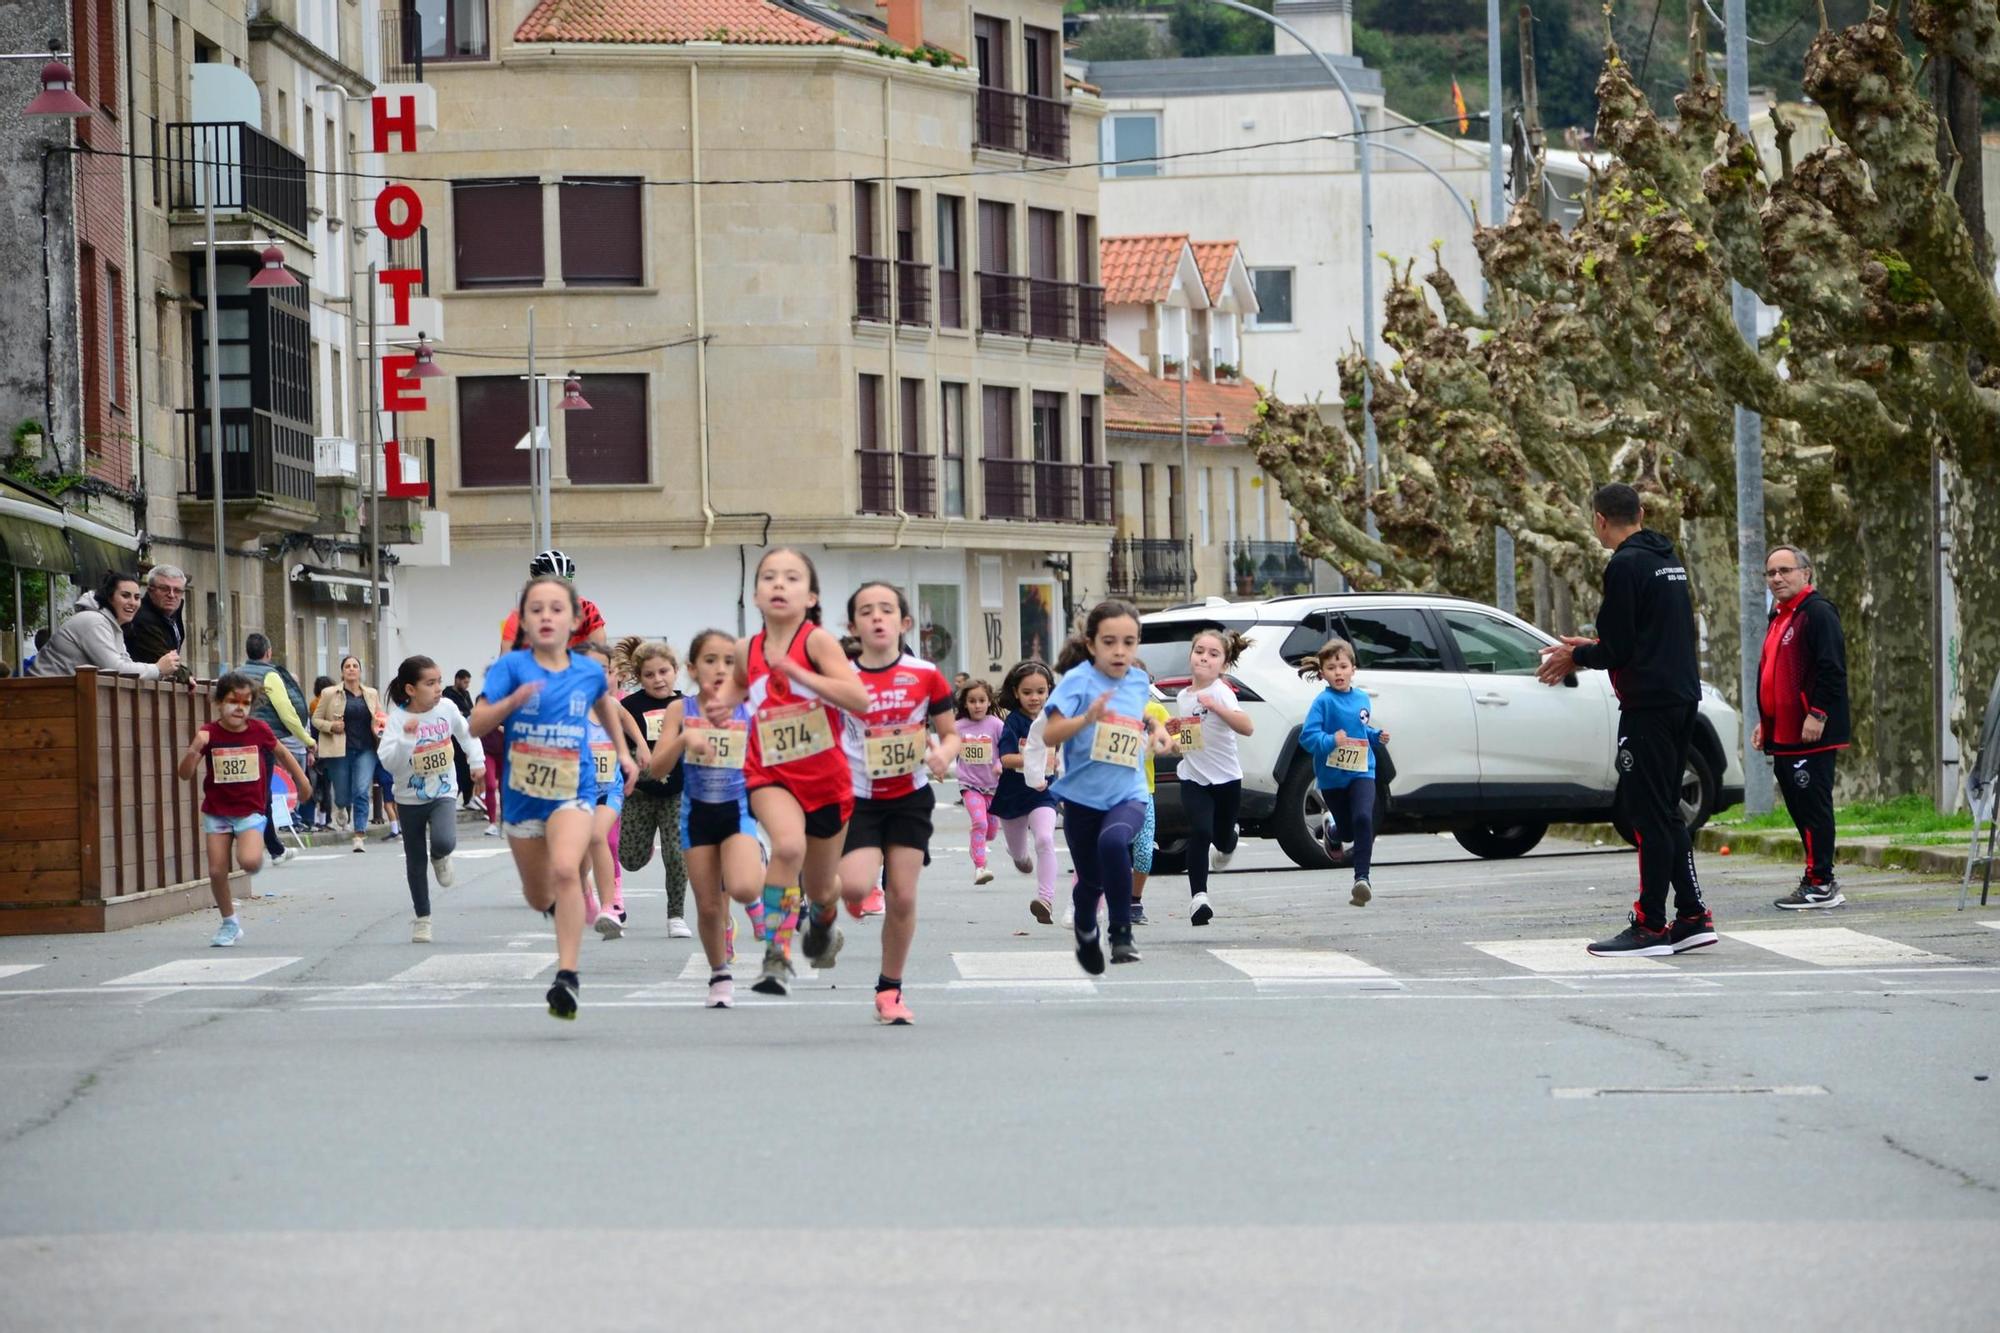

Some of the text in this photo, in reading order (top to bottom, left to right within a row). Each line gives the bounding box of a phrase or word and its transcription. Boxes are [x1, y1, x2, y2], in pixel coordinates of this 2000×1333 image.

[372, 96, 429, 497] HOTEL
[983, 612, 1003, 661] VB
[773, 724, 812, 752] 374
[1109, 732, 1138, 757] 372
[1180, 730, 1192, 744] 86
[422, 752, 447, 770] 388
[881, 742, 916, 766] 364
[965, 747, 983, 759] 390
[1337, 748, 1359, 764] 377
[222, 759, 248, 775] 382
[525, 763, 557, 788] 371
